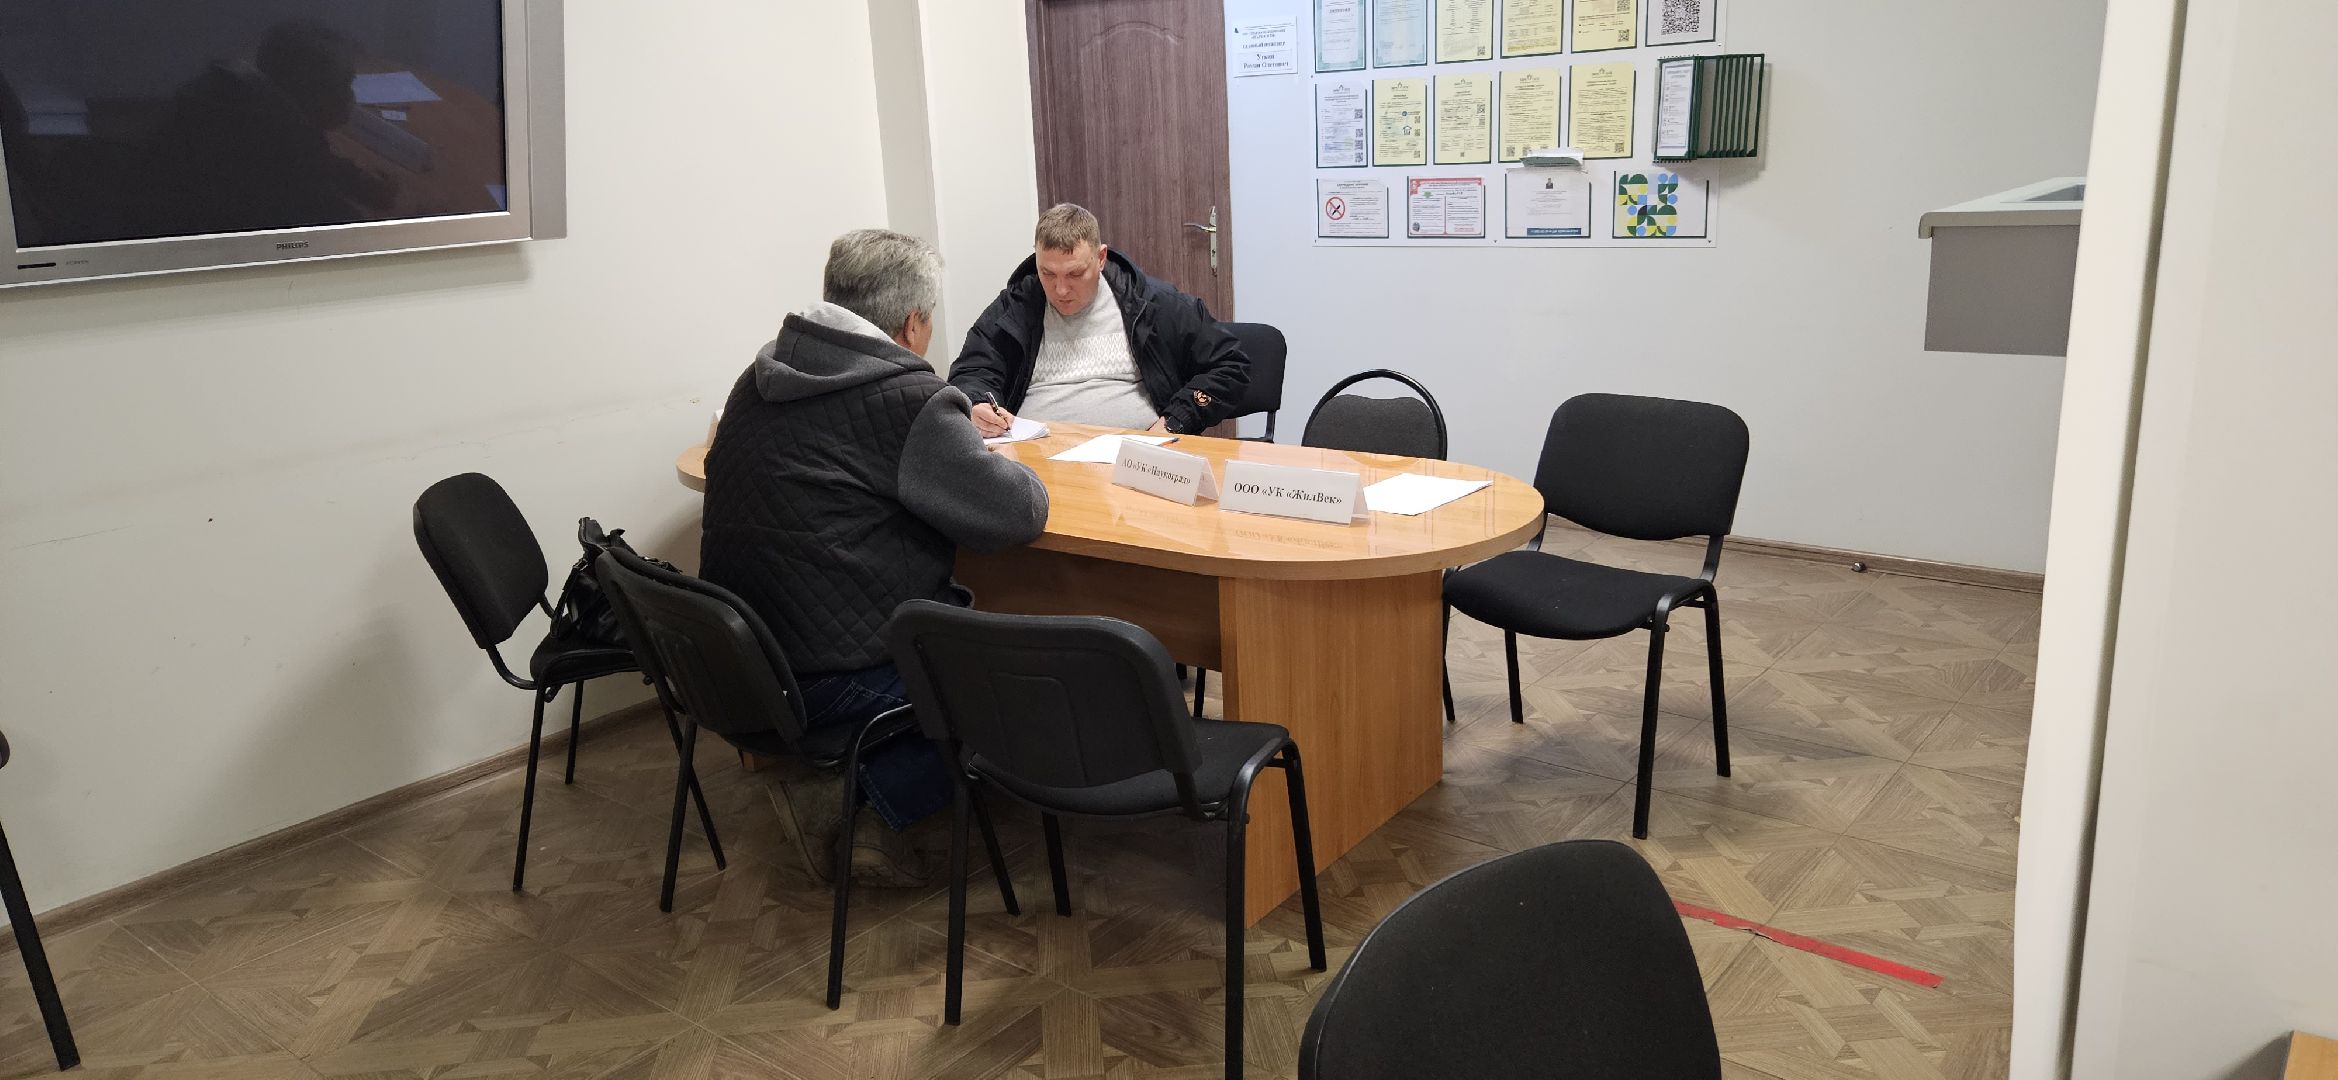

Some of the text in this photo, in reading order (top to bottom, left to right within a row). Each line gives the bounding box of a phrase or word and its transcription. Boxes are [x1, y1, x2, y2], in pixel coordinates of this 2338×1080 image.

[276, 241, 309, 250] PHILIPS
[1234, 482, 1342, 505] ООО «УК «ЖилВек»
